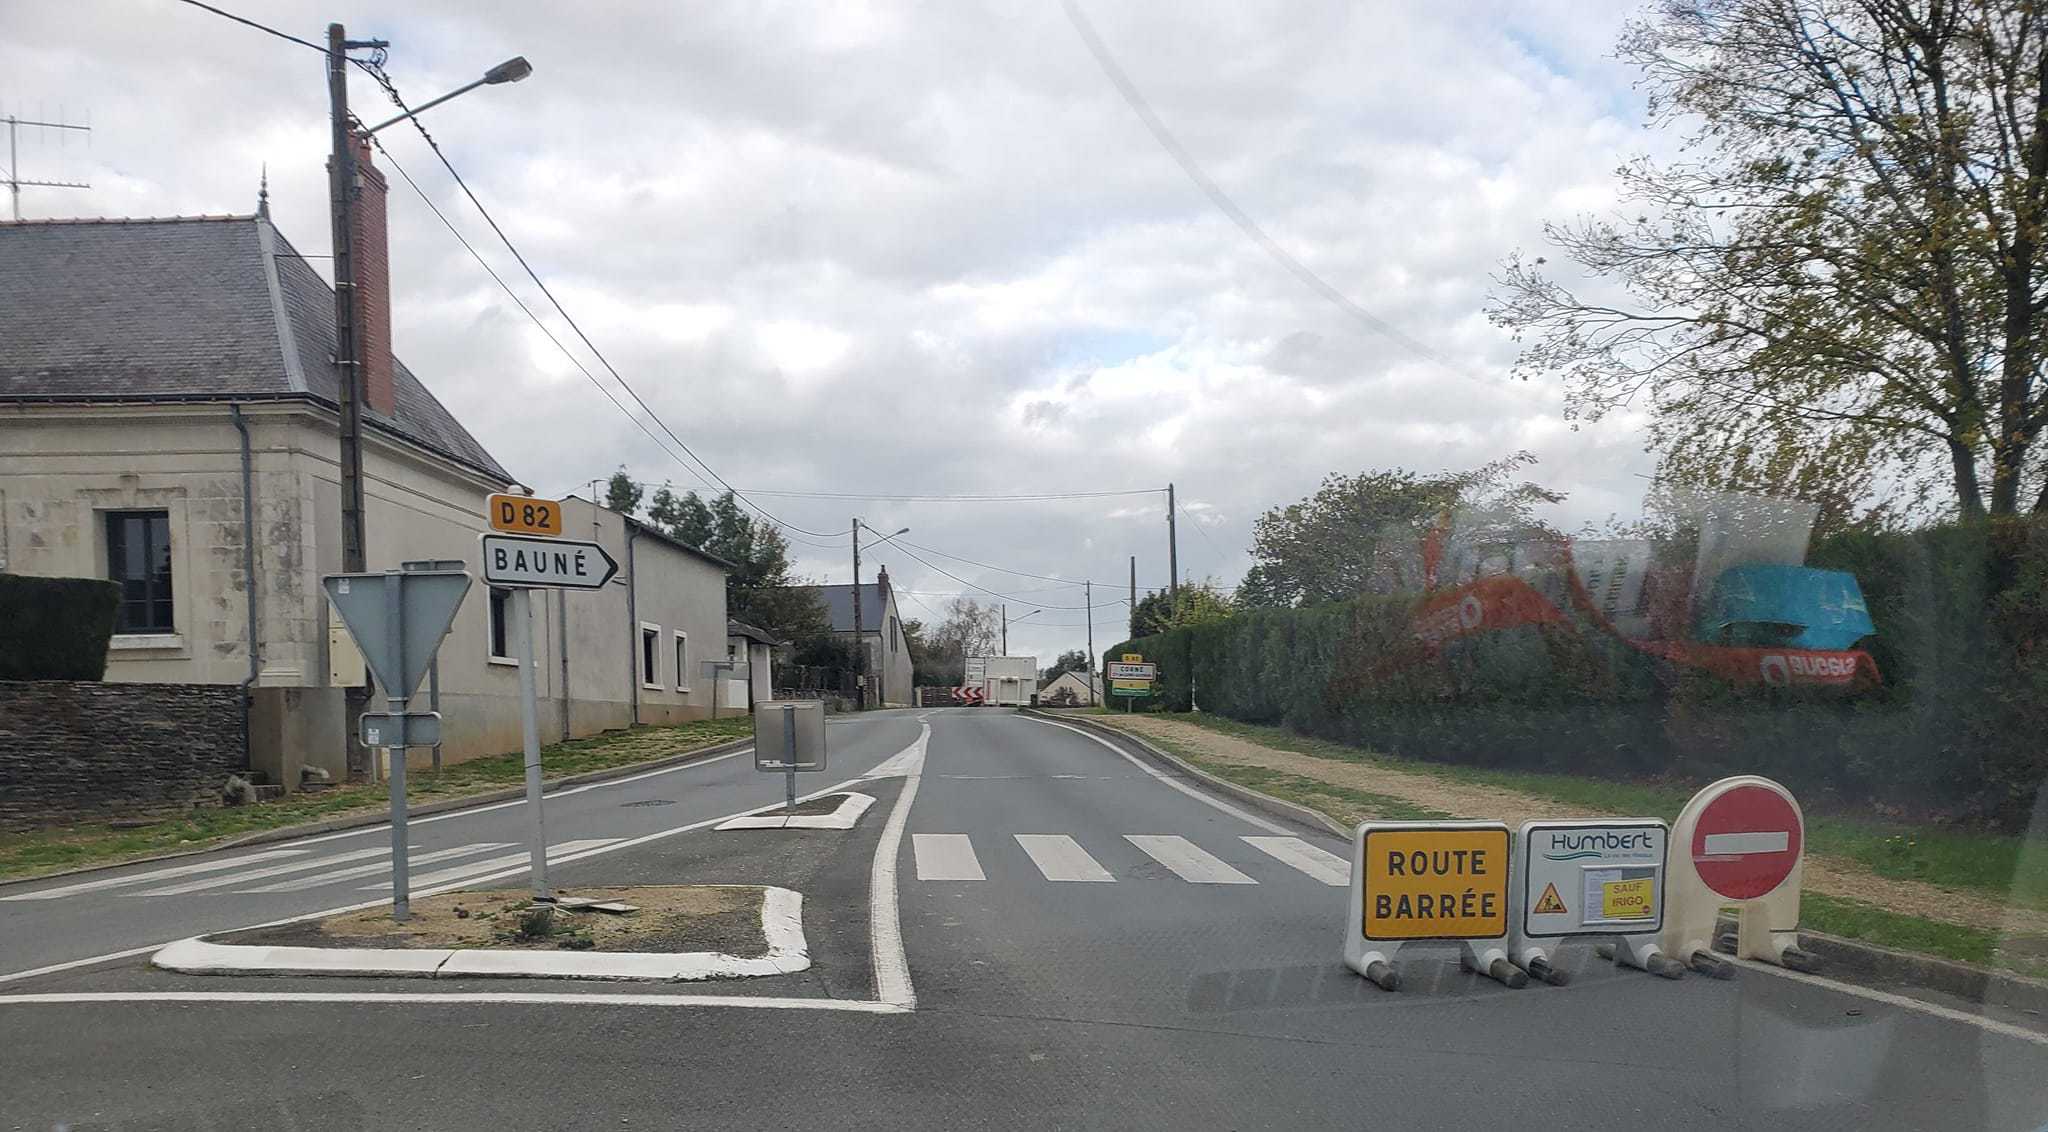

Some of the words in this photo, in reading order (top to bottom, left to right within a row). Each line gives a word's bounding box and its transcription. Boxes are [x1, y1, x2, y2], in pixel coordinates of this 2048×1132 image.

[501, 502, 515, 524] D
[522, 504, 550, 529] 82
[494, 547, 587, 577] BAUNÉ
[1551, 831, 1653, 850] Humbert
[1388, 850, 1487, 876] ROUTE
[1613, 881, 1644, 895] SAUF
[1375, 887, 1497, 919] BARRÉE
[1611, 895, 1644, 908] IRIGO
